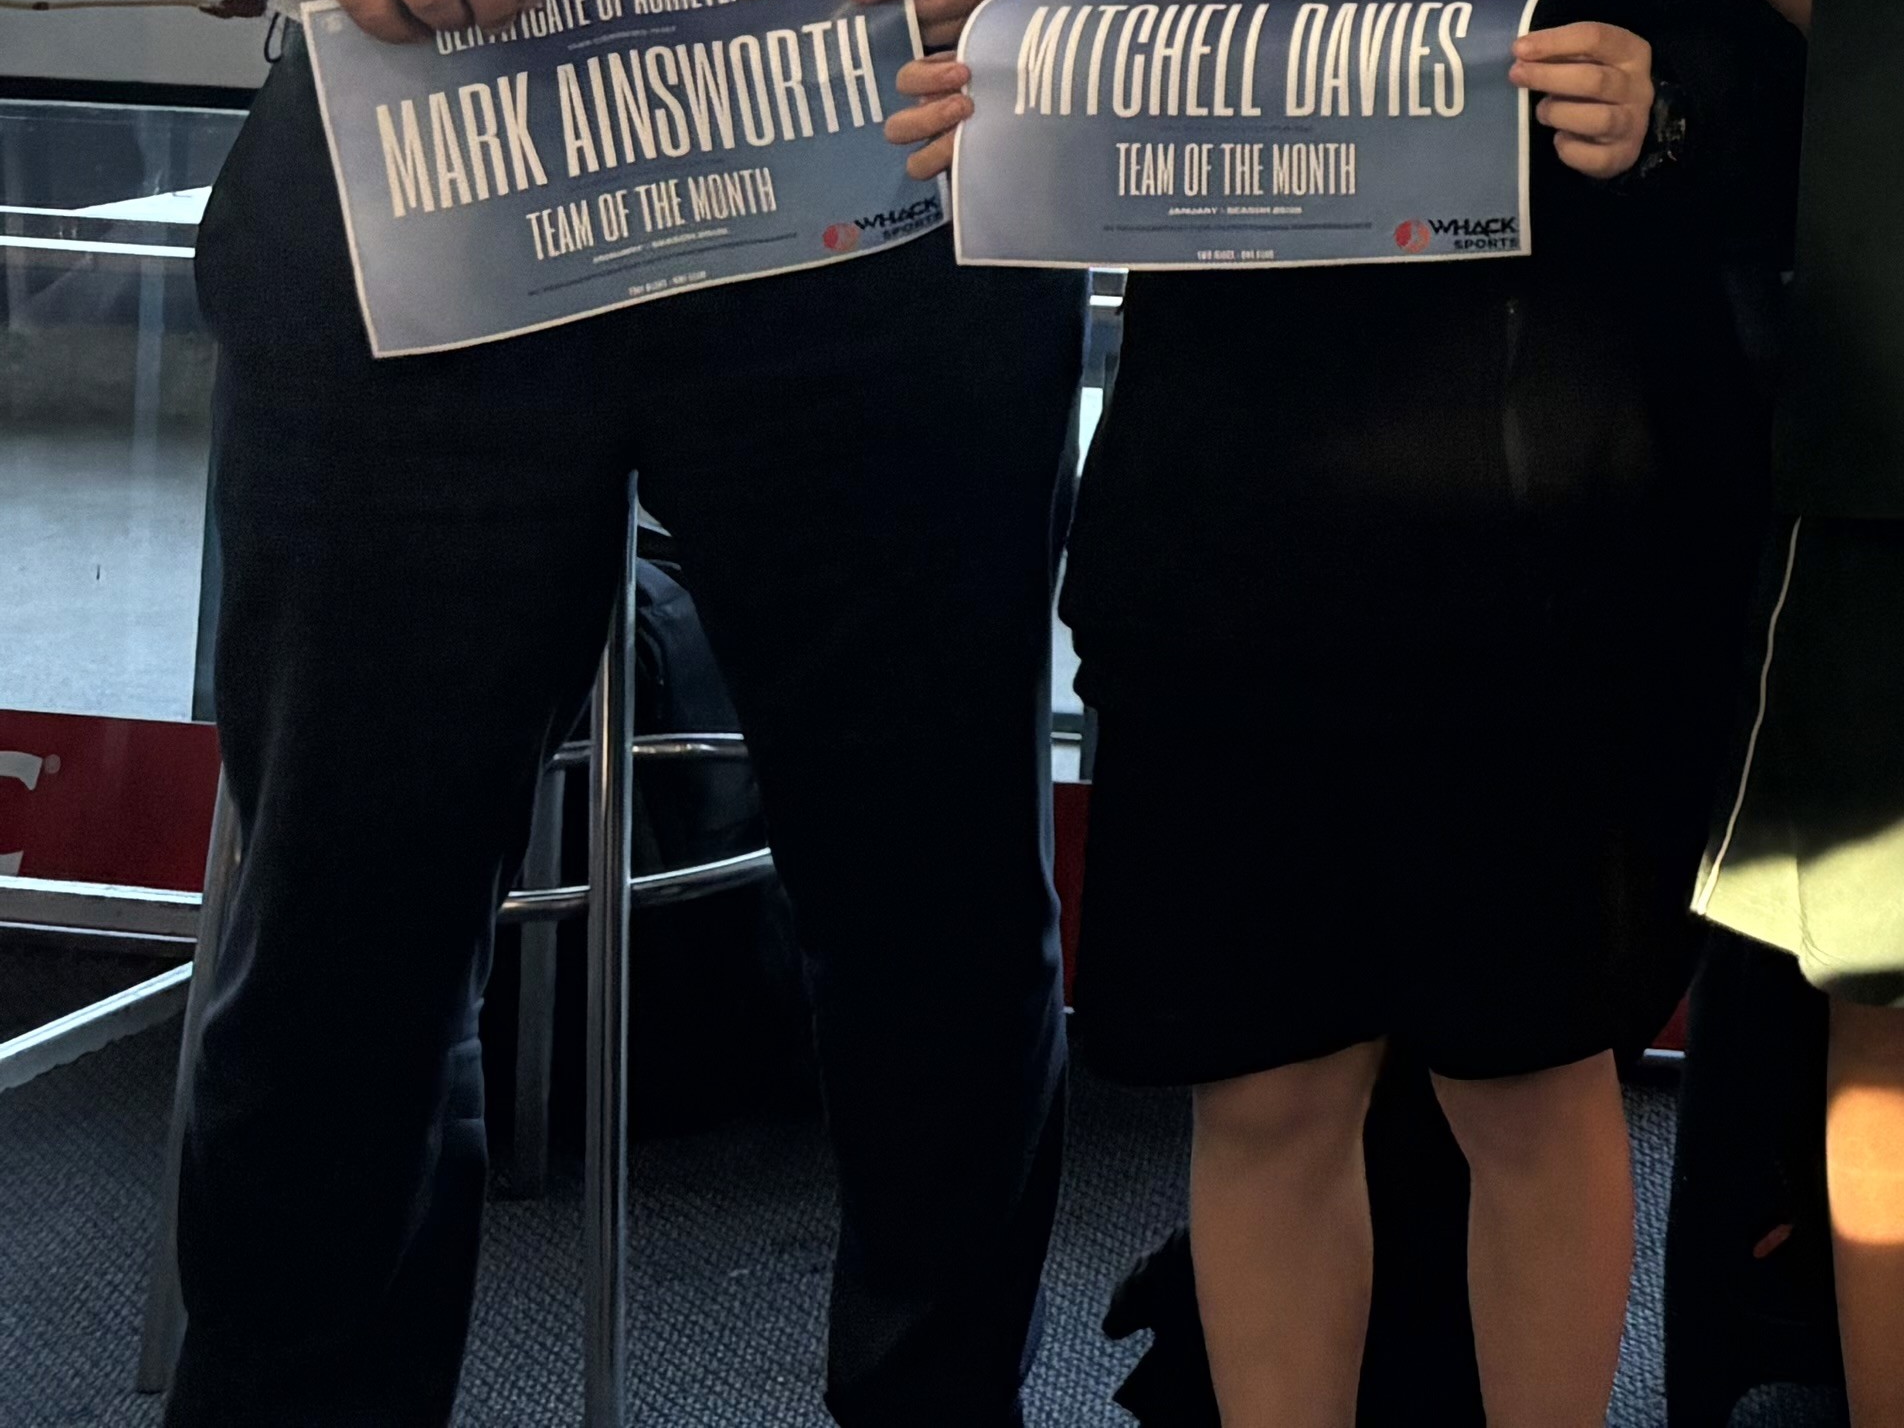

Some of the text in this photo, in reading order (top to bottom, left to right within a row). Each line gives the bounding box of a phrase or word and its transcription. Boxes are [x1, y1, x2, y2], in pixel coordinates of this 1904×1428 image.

[375, 71, 549, 218] MARK
[556, 14, 885, 178] AINSWORTH
[1014, 1, 1473, 118] MITCHELL DAVIES
